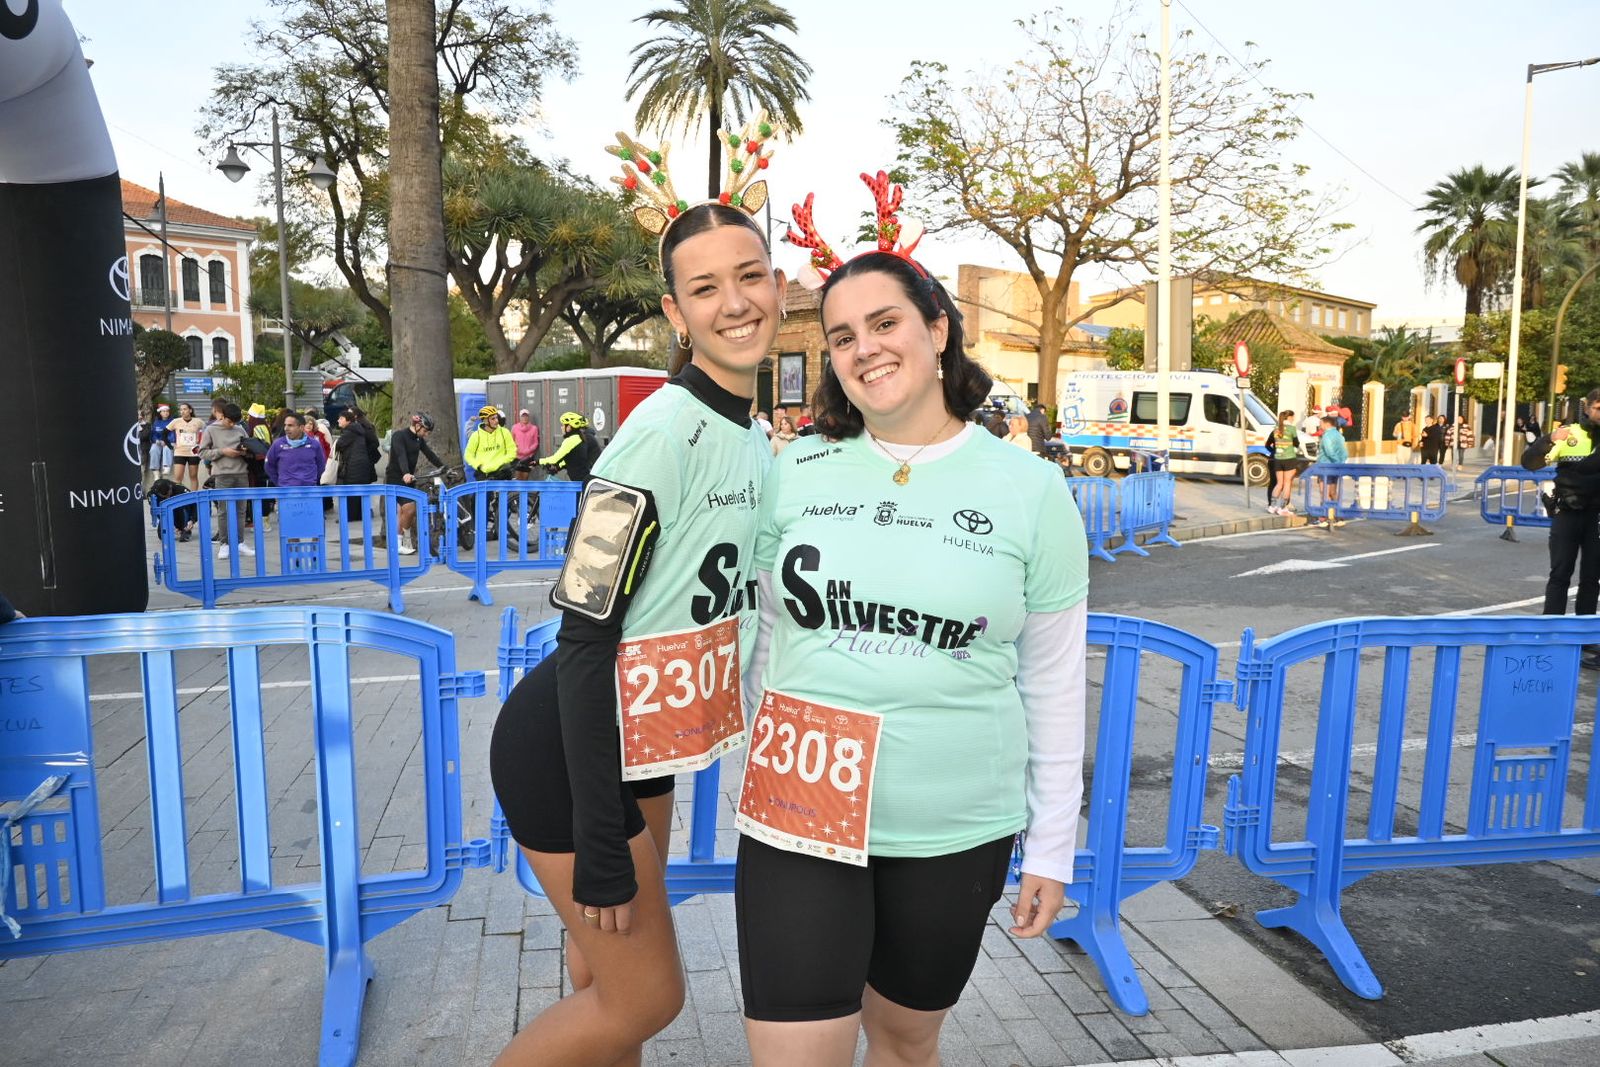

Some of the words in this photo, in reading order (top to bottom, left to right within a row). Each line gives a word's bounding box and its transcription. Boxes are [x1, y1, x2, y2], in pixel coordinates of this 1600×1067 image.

[796, 448, 830, 465] luanvi
[69, 485, 131, 509] NIMO
[707, 490, 746, 509] Huelva
[802, 502, 858, 518] Huelva
[896, 518, 933, 529] HUELVA
[943, 535, 995, 556] HUELVA
[656, 641, 684, 653] Huelva
[828, 622, 935, 658] Huelva
[626, 640, 737, 717] 2307
[751, 715, 863, 793] 2308
